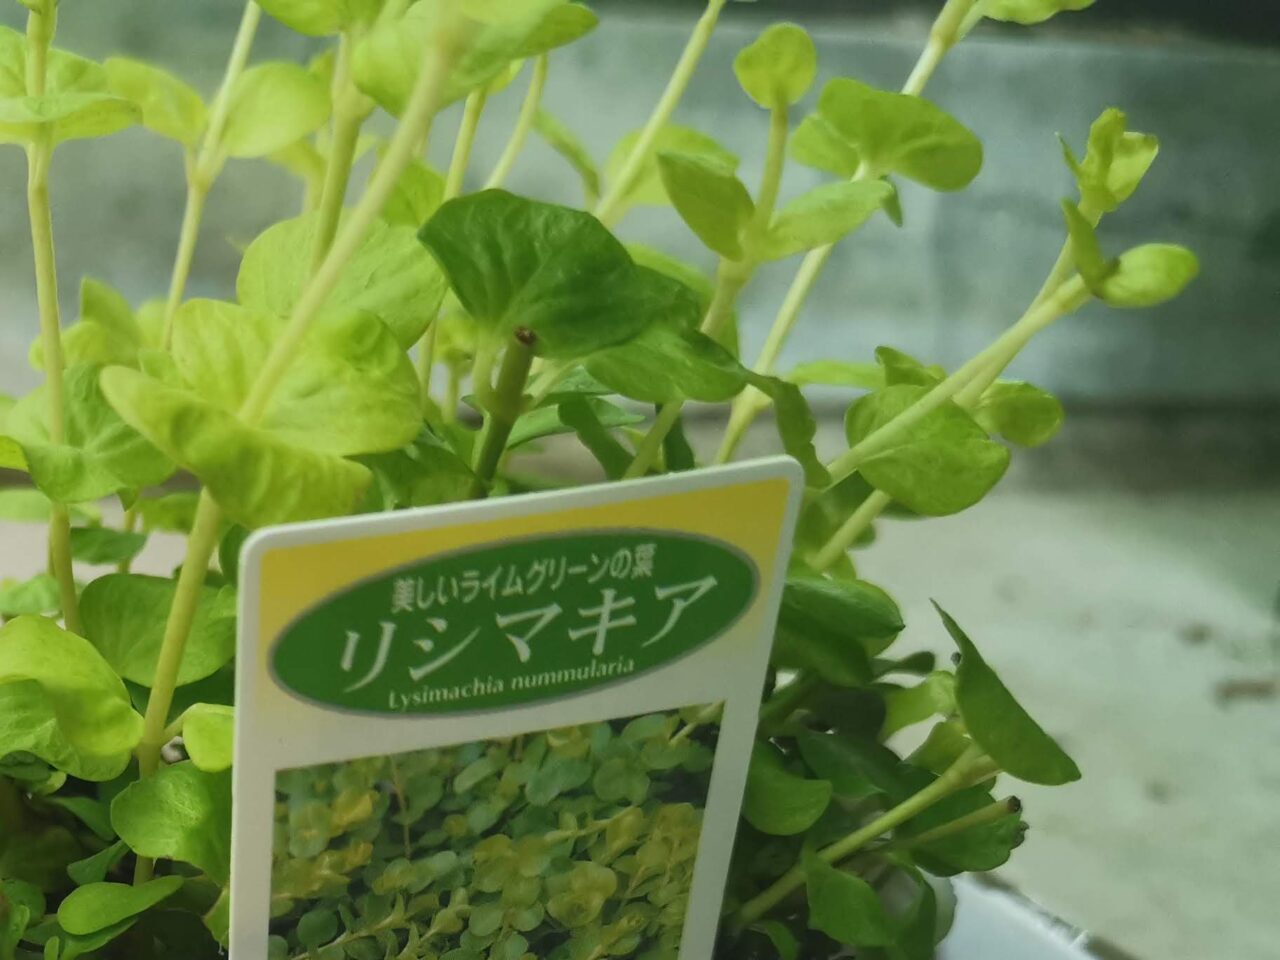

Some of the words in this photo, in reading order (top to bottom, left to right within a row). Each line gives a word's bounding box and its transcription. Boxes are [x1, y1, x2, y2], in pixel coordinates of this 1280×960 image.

[339, 575, 718, 693] リシマキア
[388, 676, 505, 711] Lysimachia
[511, 657, 635, 692] nummularia
